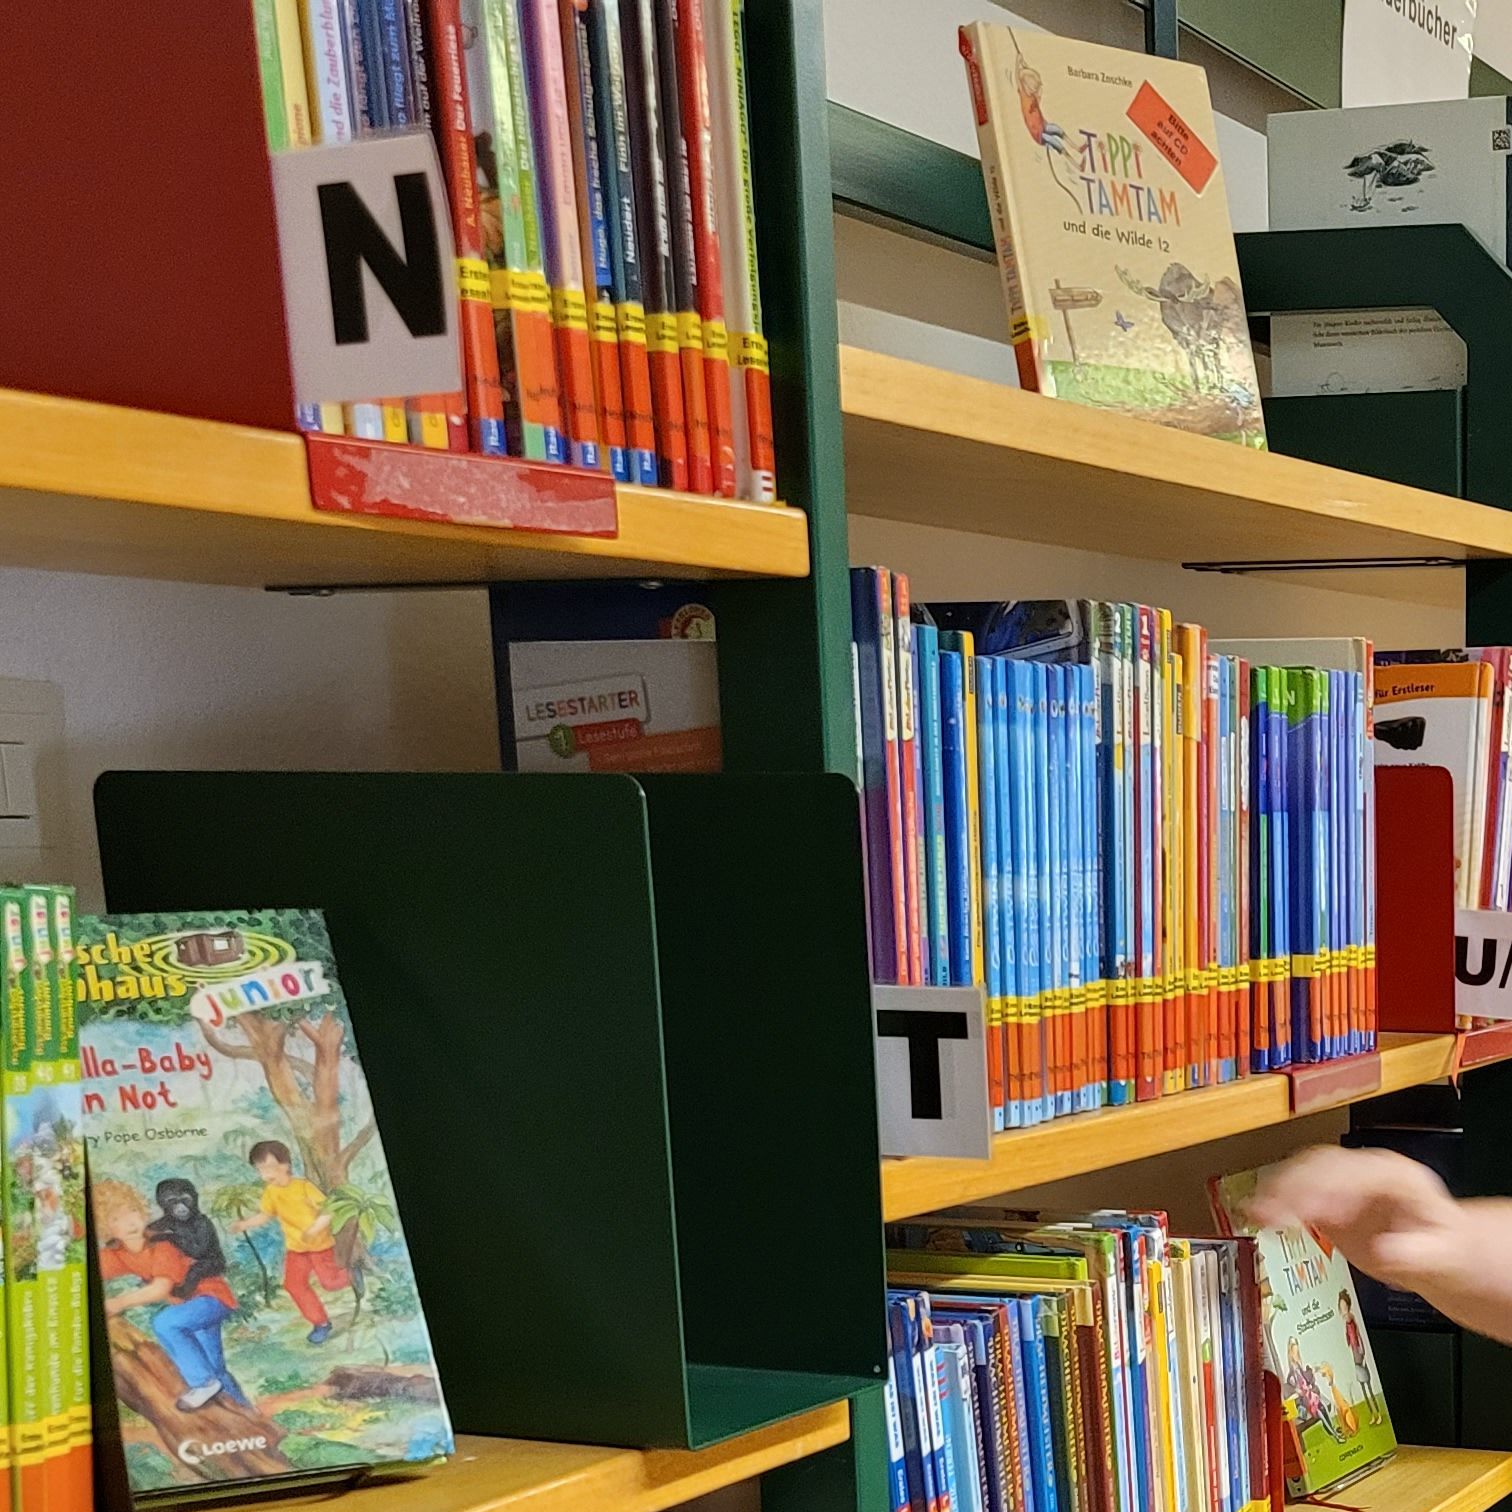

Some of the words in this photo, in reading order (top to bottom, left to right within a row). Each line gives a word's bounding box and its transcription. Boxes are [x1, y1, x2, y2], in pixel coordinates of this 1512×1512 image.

[446, 24, 463, 101] Feuerriese
[1067, 65, 1099, 81] Barbara
[453, 105, 467, 132] Der
[1168, 114, 1189, 141] Bitte
[1151, 131, 1182, 166] achten
[1157, 121, 1172, 137] auf
[1174, 138, 1189, 156] CD
[1080, 176, 1181, 227] TAMTAM
[1063, 221, 1086, 234] und
[1092, 224, 1111, 240] die
[1116, 228, 1152, 249] Wilde
[1158, 238, 1170, 253] 12
[317, 172, 448, 345] N
[525, 690, 640, 722] LESESTARTER
[1374, 686, 1389, 699] für
[1392, 683, 1436, 697] Erstleser
[876, 1009, 969, 1120] T
[119, 1082, 178, 1112] Not
[104, 1131, 139, 1145] Pope
[145, 1127, 208, 1140] Osborne
